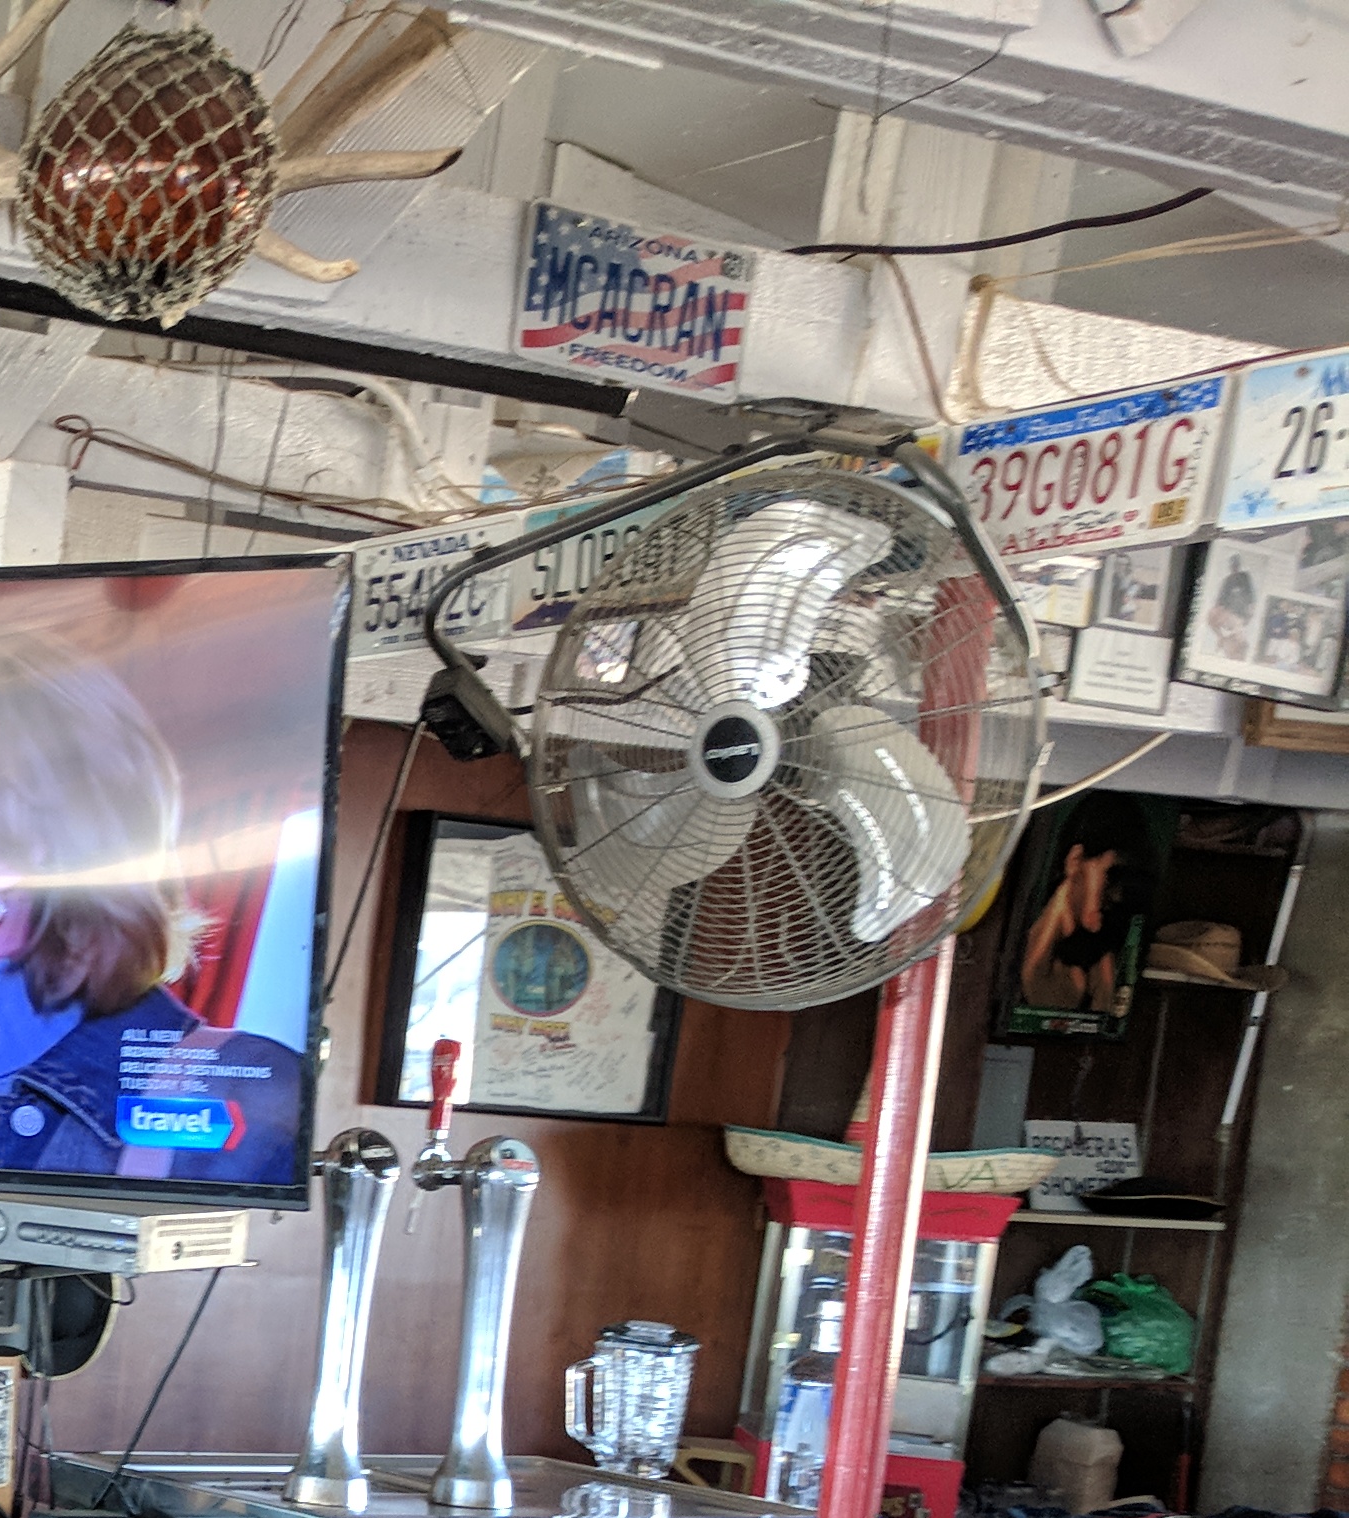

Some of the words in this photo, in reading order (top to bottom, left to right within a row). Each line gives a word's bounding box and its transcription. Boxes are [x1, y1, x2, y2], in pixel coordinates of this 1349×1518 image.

[589, 226, 700, 265] ARIZONA
[541, 246, 733, 363] MCACRAN
[568, 343, 690, 382] FREEDOM
[971, 418, 1196, 523] 39G081G
[392, 533, 470, 564] NEVADA
[118, 1077, 180, 1090] TUESDAY
[119, 1061, 183, 1074] DELICIOUS
[184, 1063, 273, 1079] DESTINATIONS
[130, 1104, 213, 1133] travel
